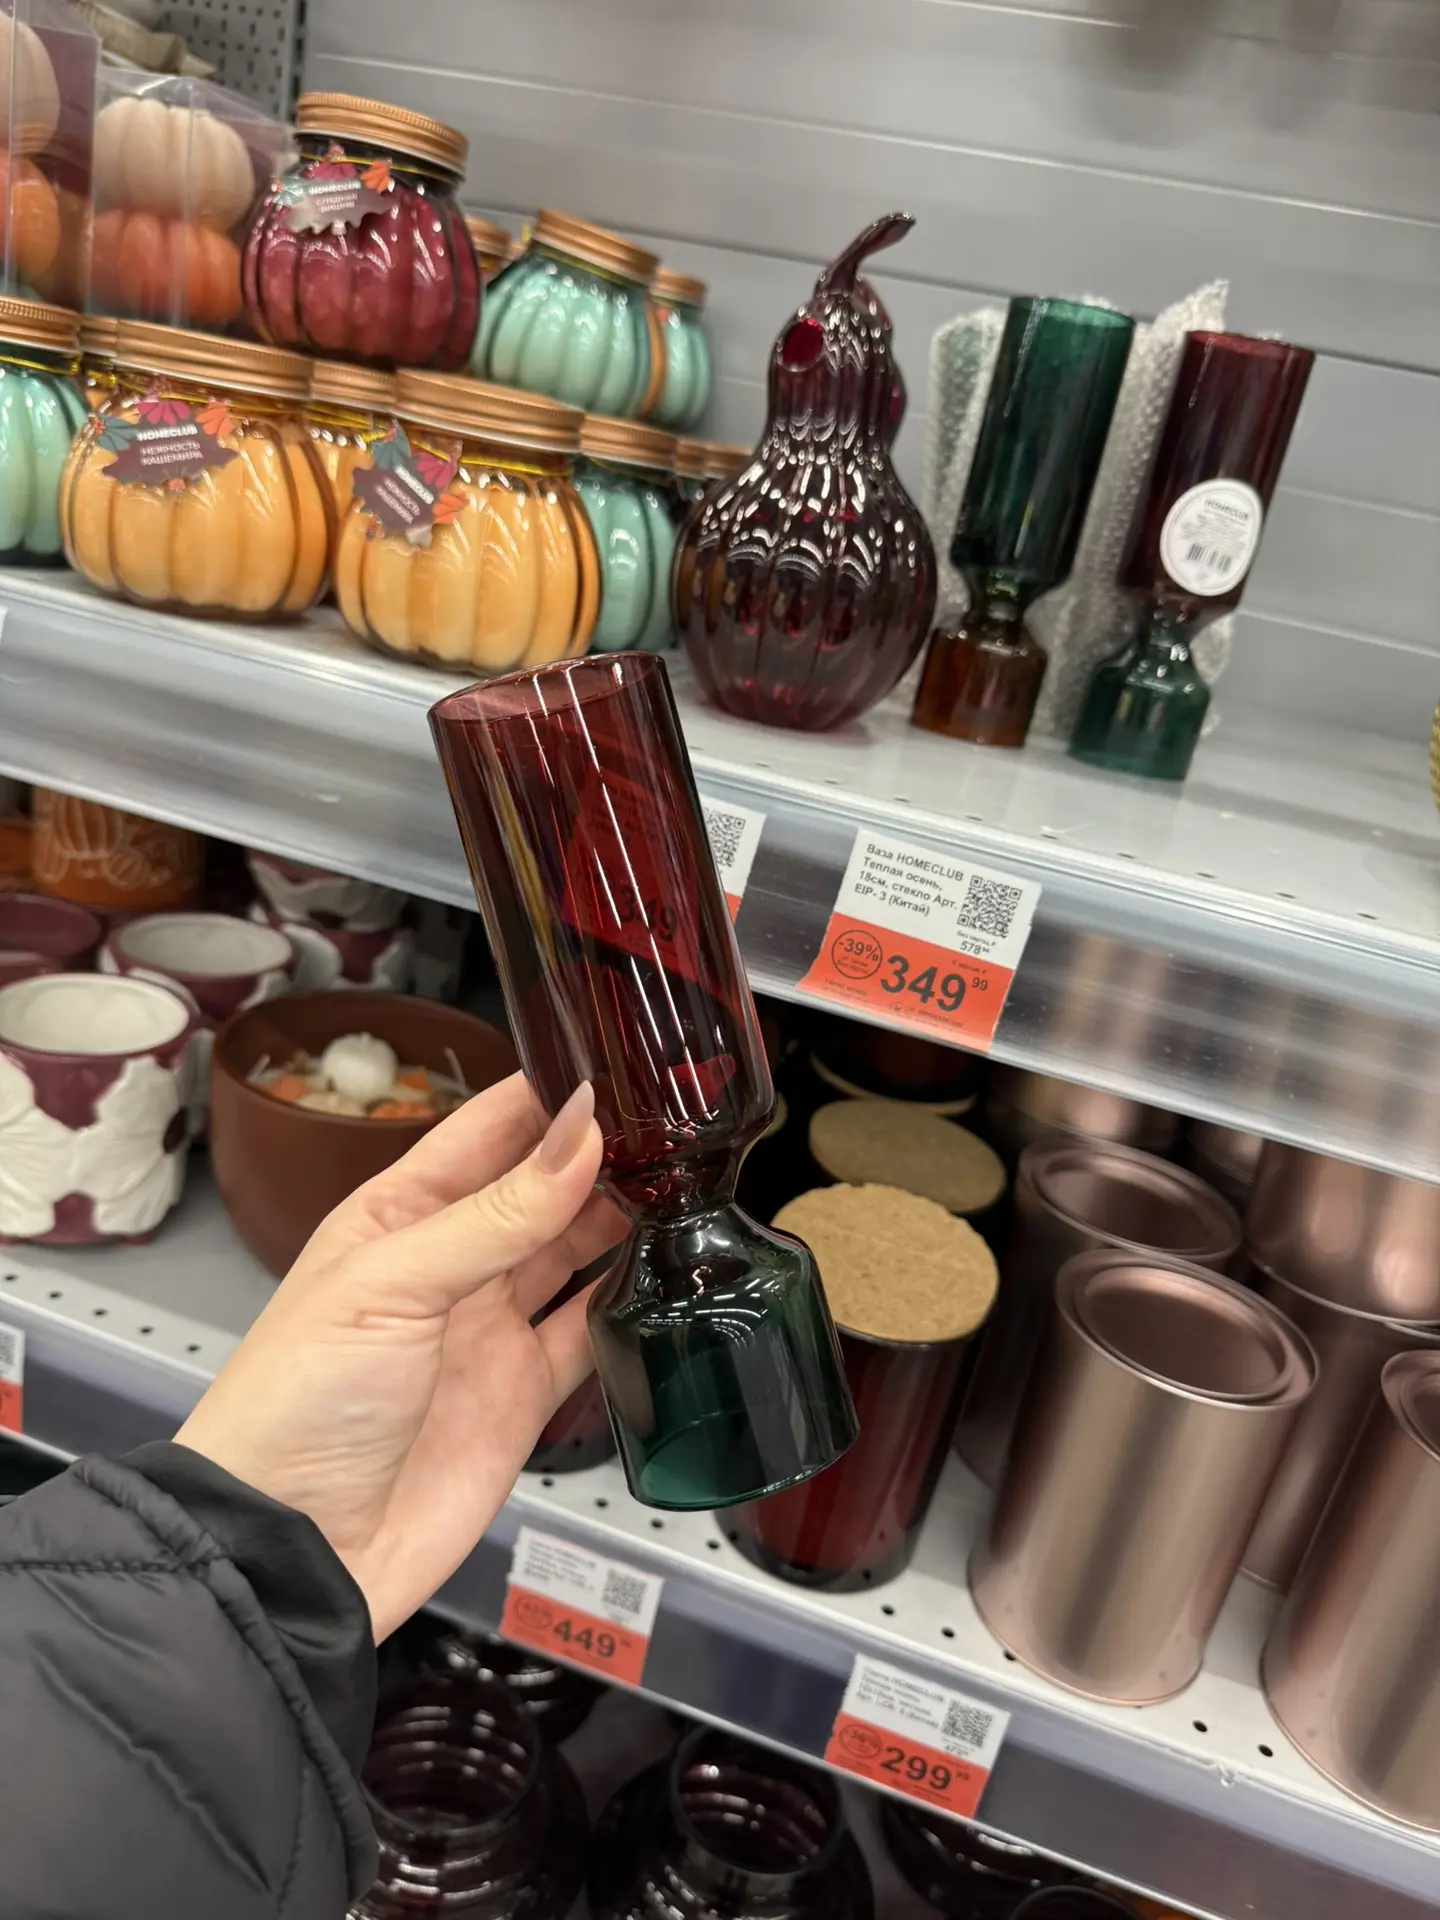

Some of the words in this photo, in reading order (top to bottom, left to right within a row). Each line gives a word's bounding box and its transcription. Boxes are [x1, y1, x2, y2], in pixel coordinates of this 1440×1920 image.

[136, 423, 199, 441] HOMECLUB
[140, 440, 201, 456] НЕЖНОСТЬ
[140, 451, 203, 466] КАШЕМИРА
[863, 857, 904, 878] Теплая
[905, 871, 943, 892] осень,
[866, 843, 894, 861] Ваза
[896, 852, 965, 882] HOMECLUB
[859, 870, 888, 889] 18см,
[891, 881, 931, 900] стекло
[932, 891, 959, 911] Арт.
[878, 890, 887, 902] 3
[888, 892, 931, 916] (Китай)
[838, 938, 879, 962] -39%
[960, 940, 982, 955] 578
[880, 954, 967, 1012] 349
[971, 976, 989, 991] 99
[553, 1618, 617, 1658] 449
[880, 1746, 952, 1790] 299
